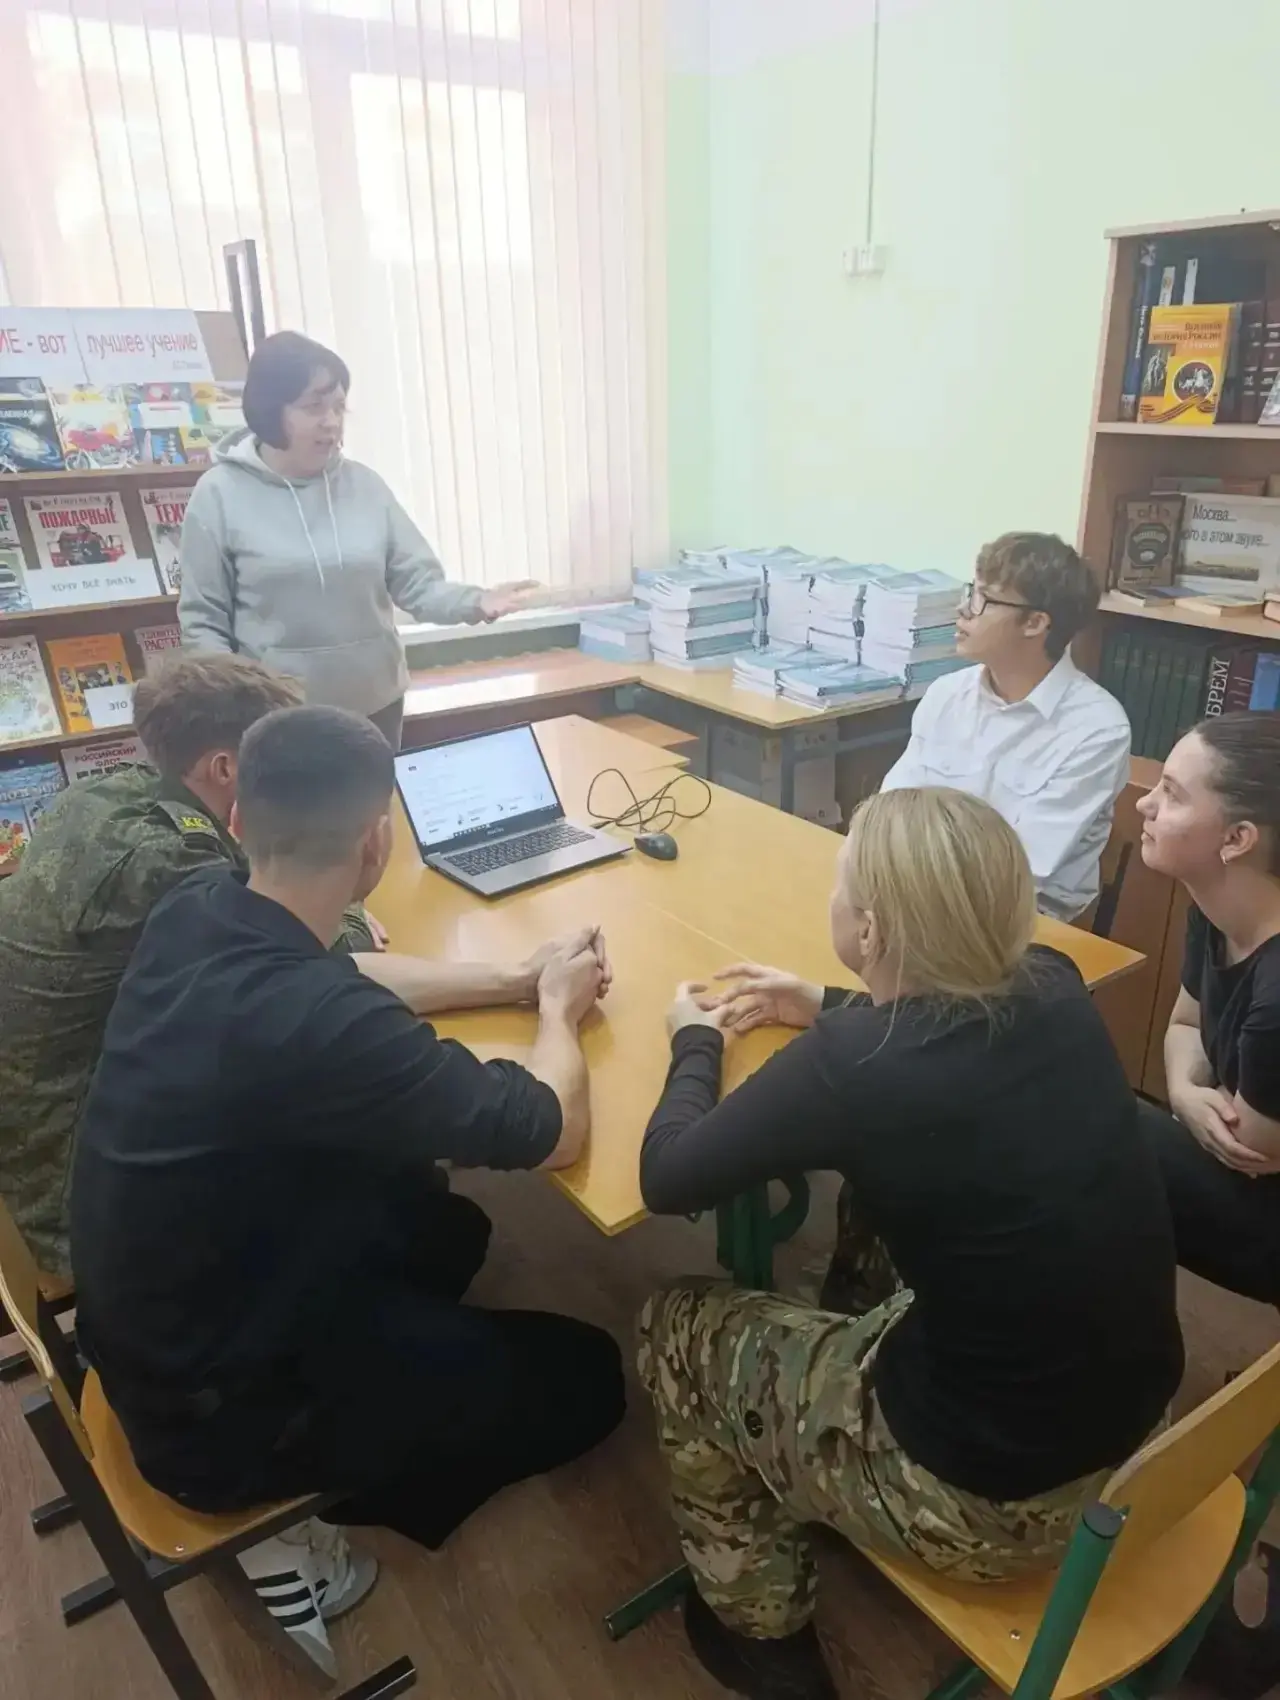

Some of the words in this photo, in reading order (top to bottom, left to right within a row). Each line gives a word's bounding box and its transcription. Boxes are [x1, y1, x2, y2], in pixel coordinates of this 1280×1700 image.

[37, 334, 67, 354] вот
[87, 333, 145, 359] лучшее
[148, 332, 199, 357] учение
[38, 508, 117, 529] ПОЖАРНЫЕ
[154, 502, 186, 524] ТЕХ
[1210, 531, 1233, 544] этом
[108, 701, 128, 711] ЭТО
[74, 746, 137, 763] РОССИЙСКИЙ
